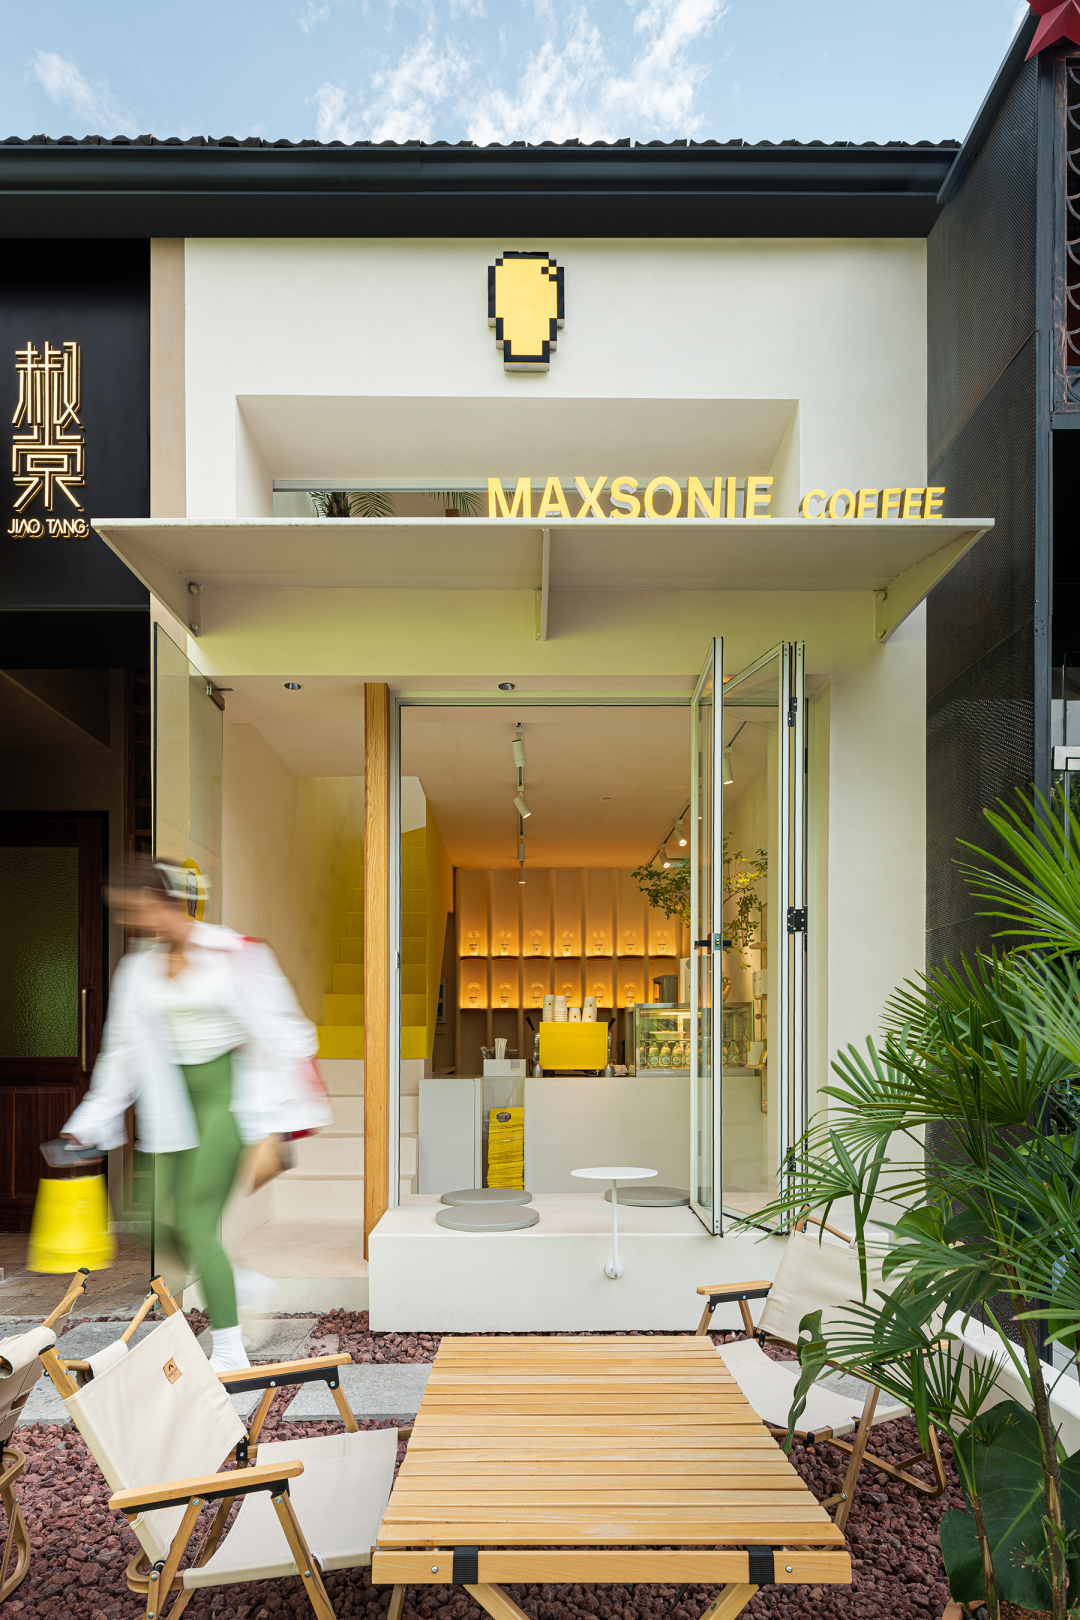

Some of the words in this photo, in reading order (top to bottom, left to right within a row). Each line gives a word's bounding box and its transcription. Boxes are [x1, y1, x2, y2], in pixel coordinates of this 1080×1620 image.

[487, 475, 774, 518] MAXSONIE
[800, 487, 946, 518] COFFEE
[7, 518, 41, 535] JIAO
[45, 518, 87, 535] TANG
